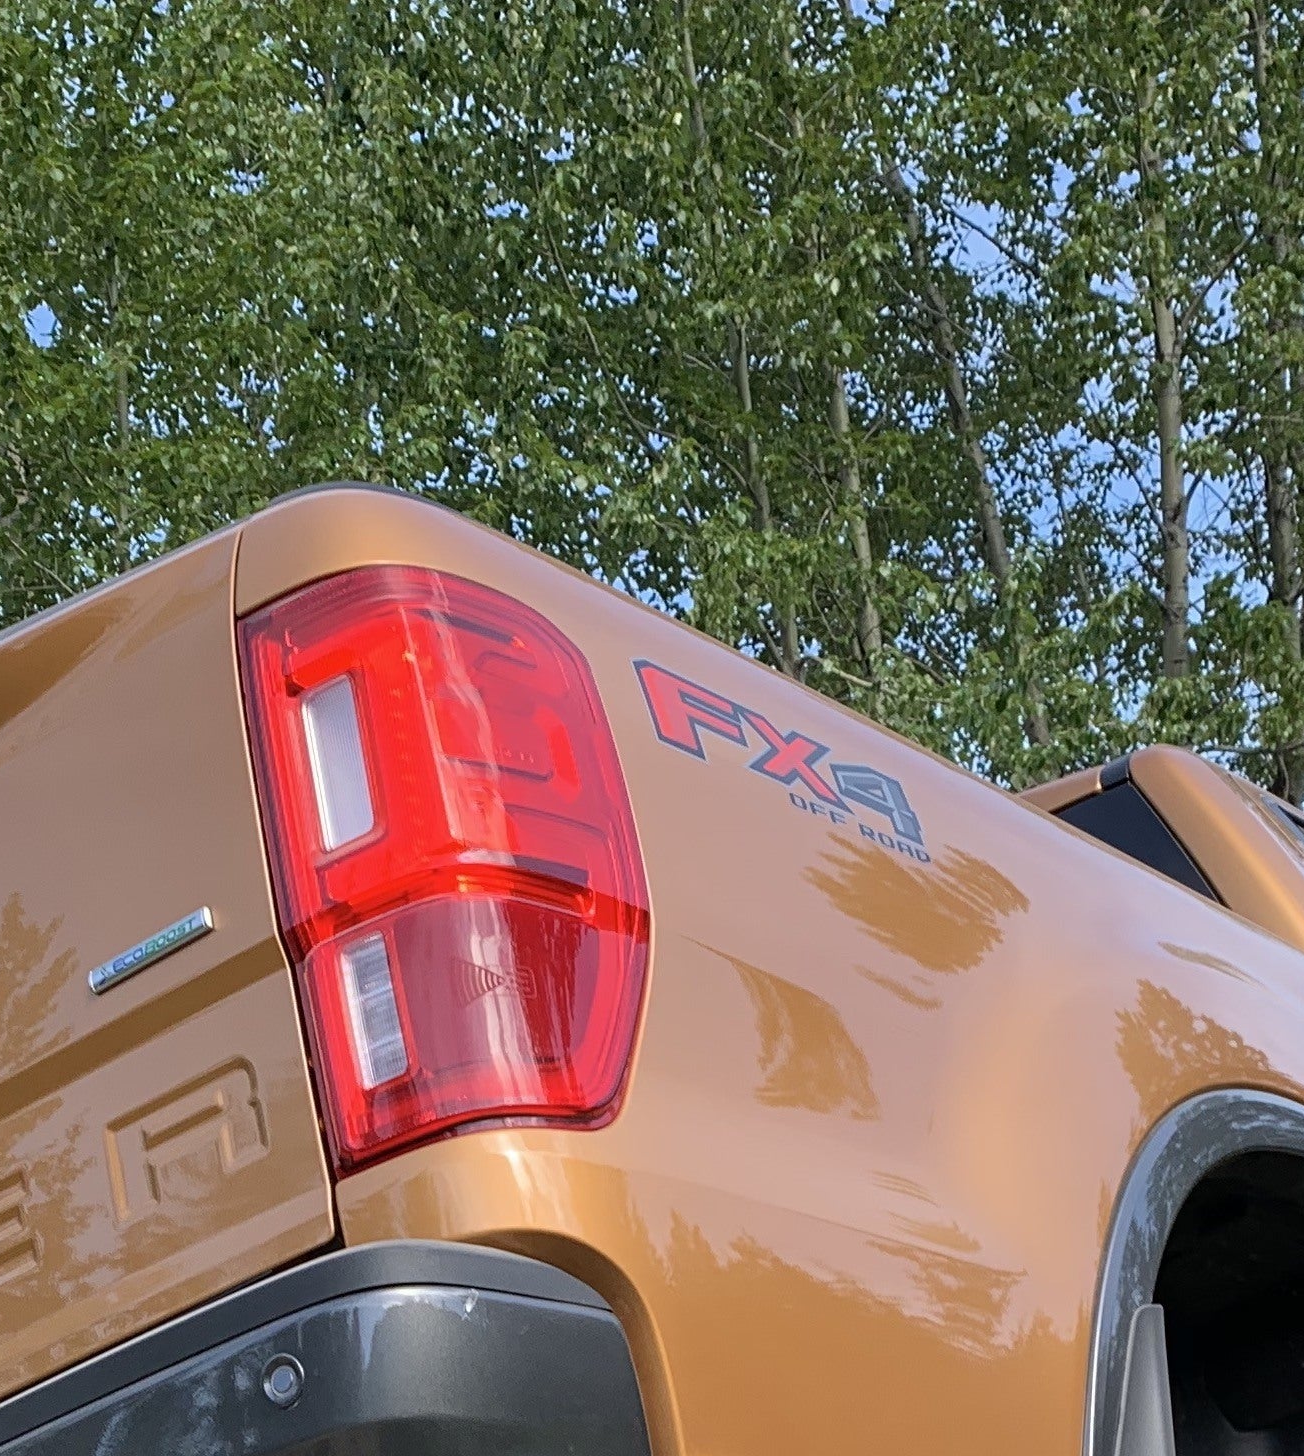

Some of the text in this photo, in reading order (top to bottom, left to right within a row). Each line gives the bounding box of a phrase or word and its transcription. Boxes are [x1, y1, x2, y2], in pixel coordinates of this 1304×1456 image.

[630, 657, 924, 846] FX4
[789, 792, 932, 863] OFF ROAD
